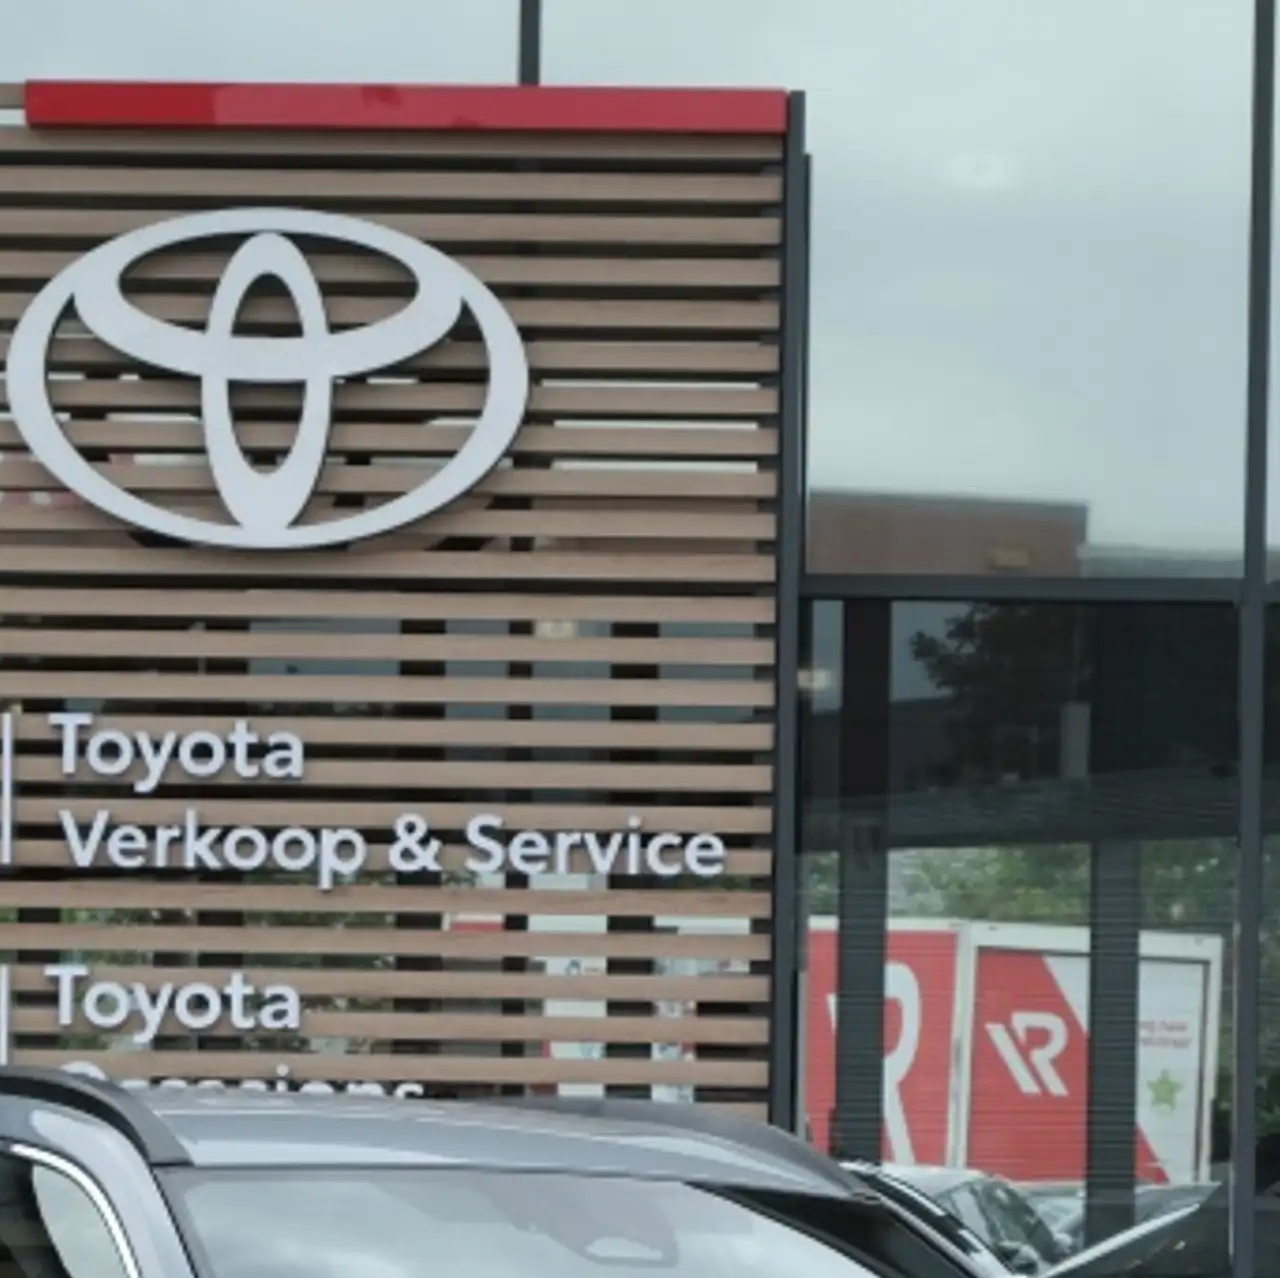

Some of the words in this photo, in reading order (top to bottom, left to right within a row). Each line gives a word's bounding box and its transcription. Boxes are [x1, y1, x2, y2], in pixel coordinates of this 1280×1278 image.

[48, 712, 305, 793] Toyota
[58, 809, 367, 890] Verkoop
[387, 813, 440, 874] &
[465, 815, 727, 877] Service
[45, 964, 302, 1045] Toyota
